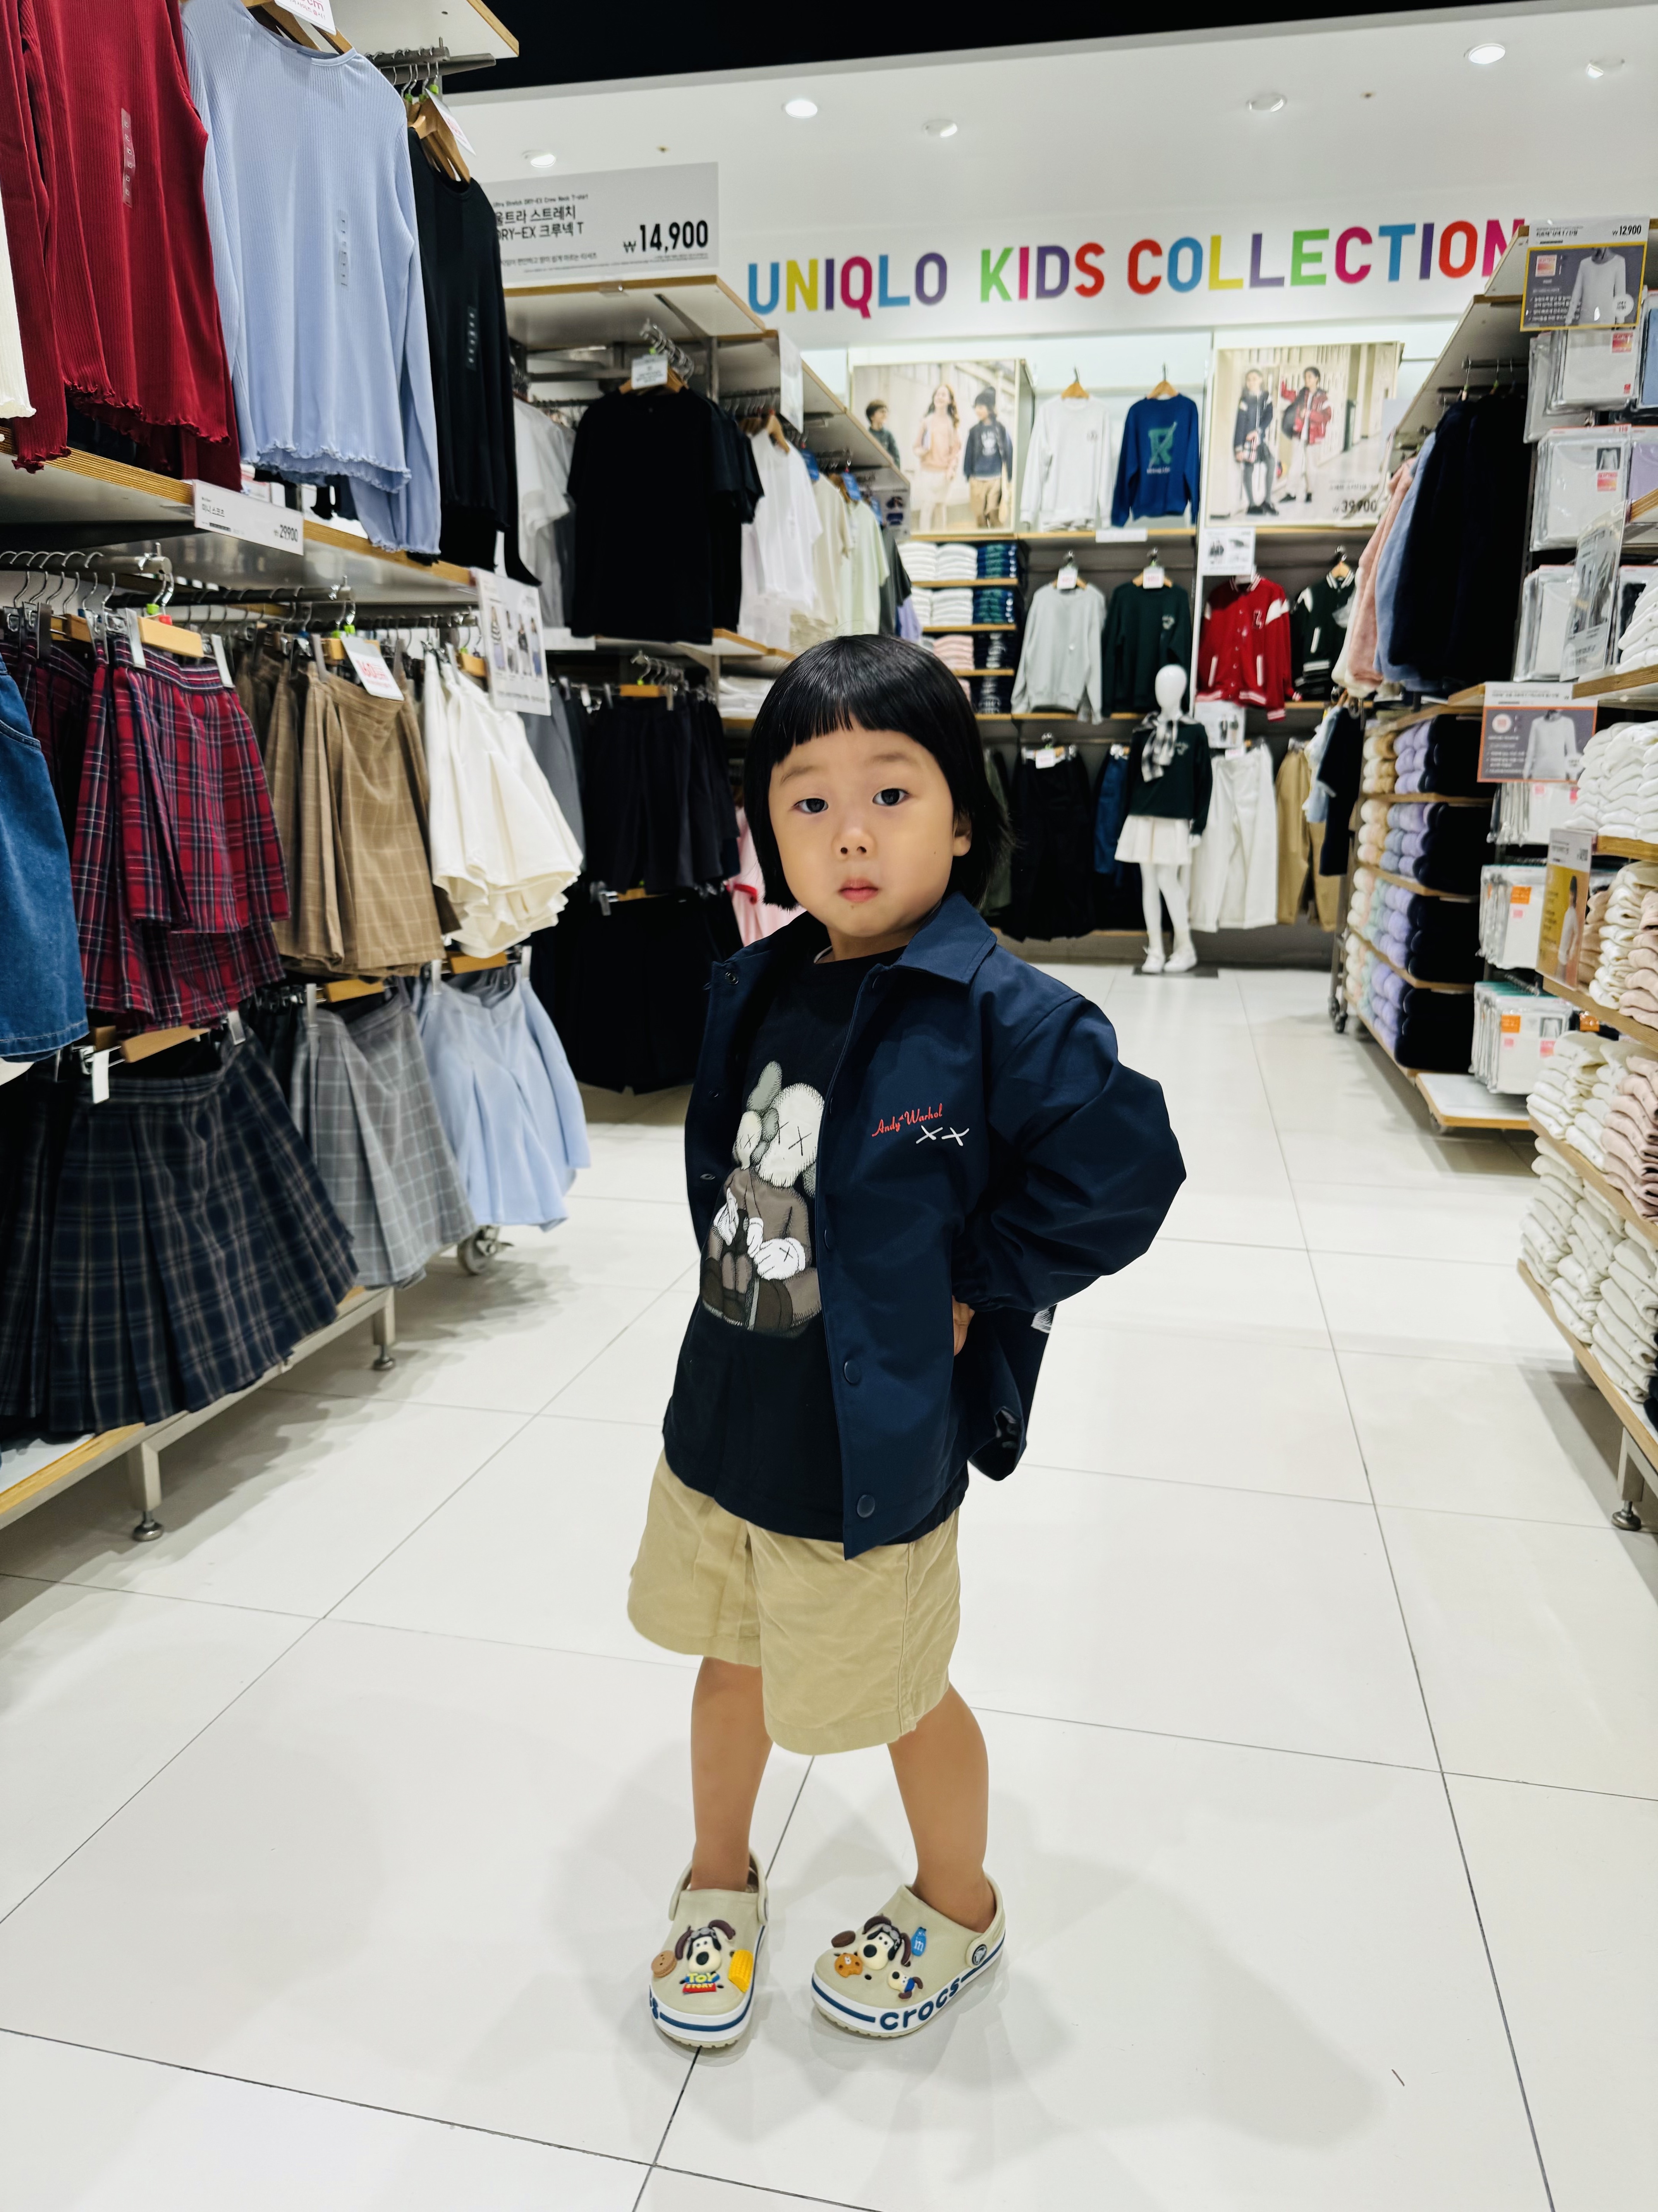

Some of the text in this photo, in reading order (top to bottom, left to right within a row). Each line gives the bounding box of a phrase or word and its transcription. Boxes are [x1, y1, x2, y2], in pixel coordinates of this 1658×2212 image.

[530, 204, 576, 222] 스트레치
[539, 222, 573, 239] 크루넥
[576, 222, 584, 234] T
[748, 218, 1525, 319] UNIQLO KIDS COLLECTION
[871, 1103, 943, 1137] Andy Warhol
[686, 1972, 716, 1983] TOY
[880, 1977, 960, 2030] crocs
